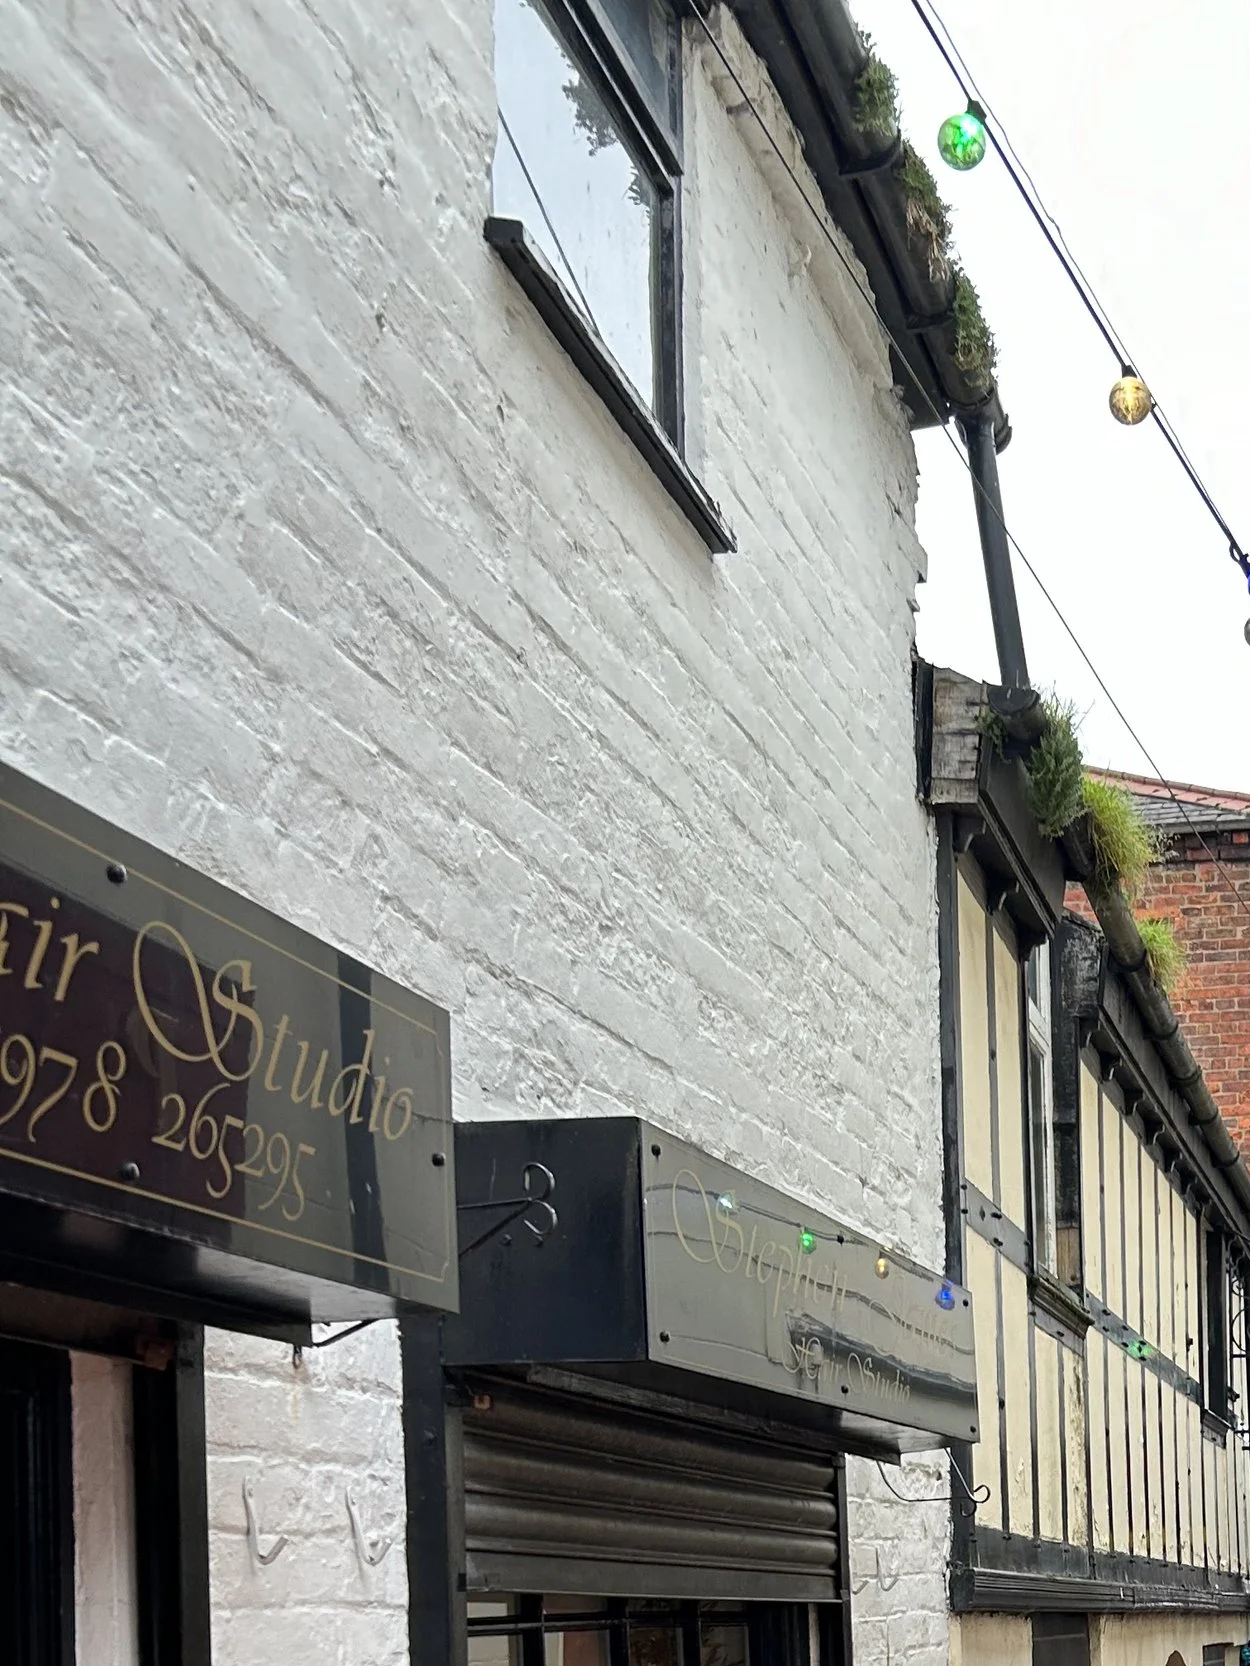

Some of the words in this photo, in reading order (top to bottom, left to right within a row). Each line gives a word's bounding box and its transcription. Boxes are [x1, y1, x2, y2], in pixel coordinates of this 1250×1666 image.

[134, 921, 414, 1140] Studio
[152, 1084, 315, 1220] 265295
[672, 1169, 848, 1318] Stephen
